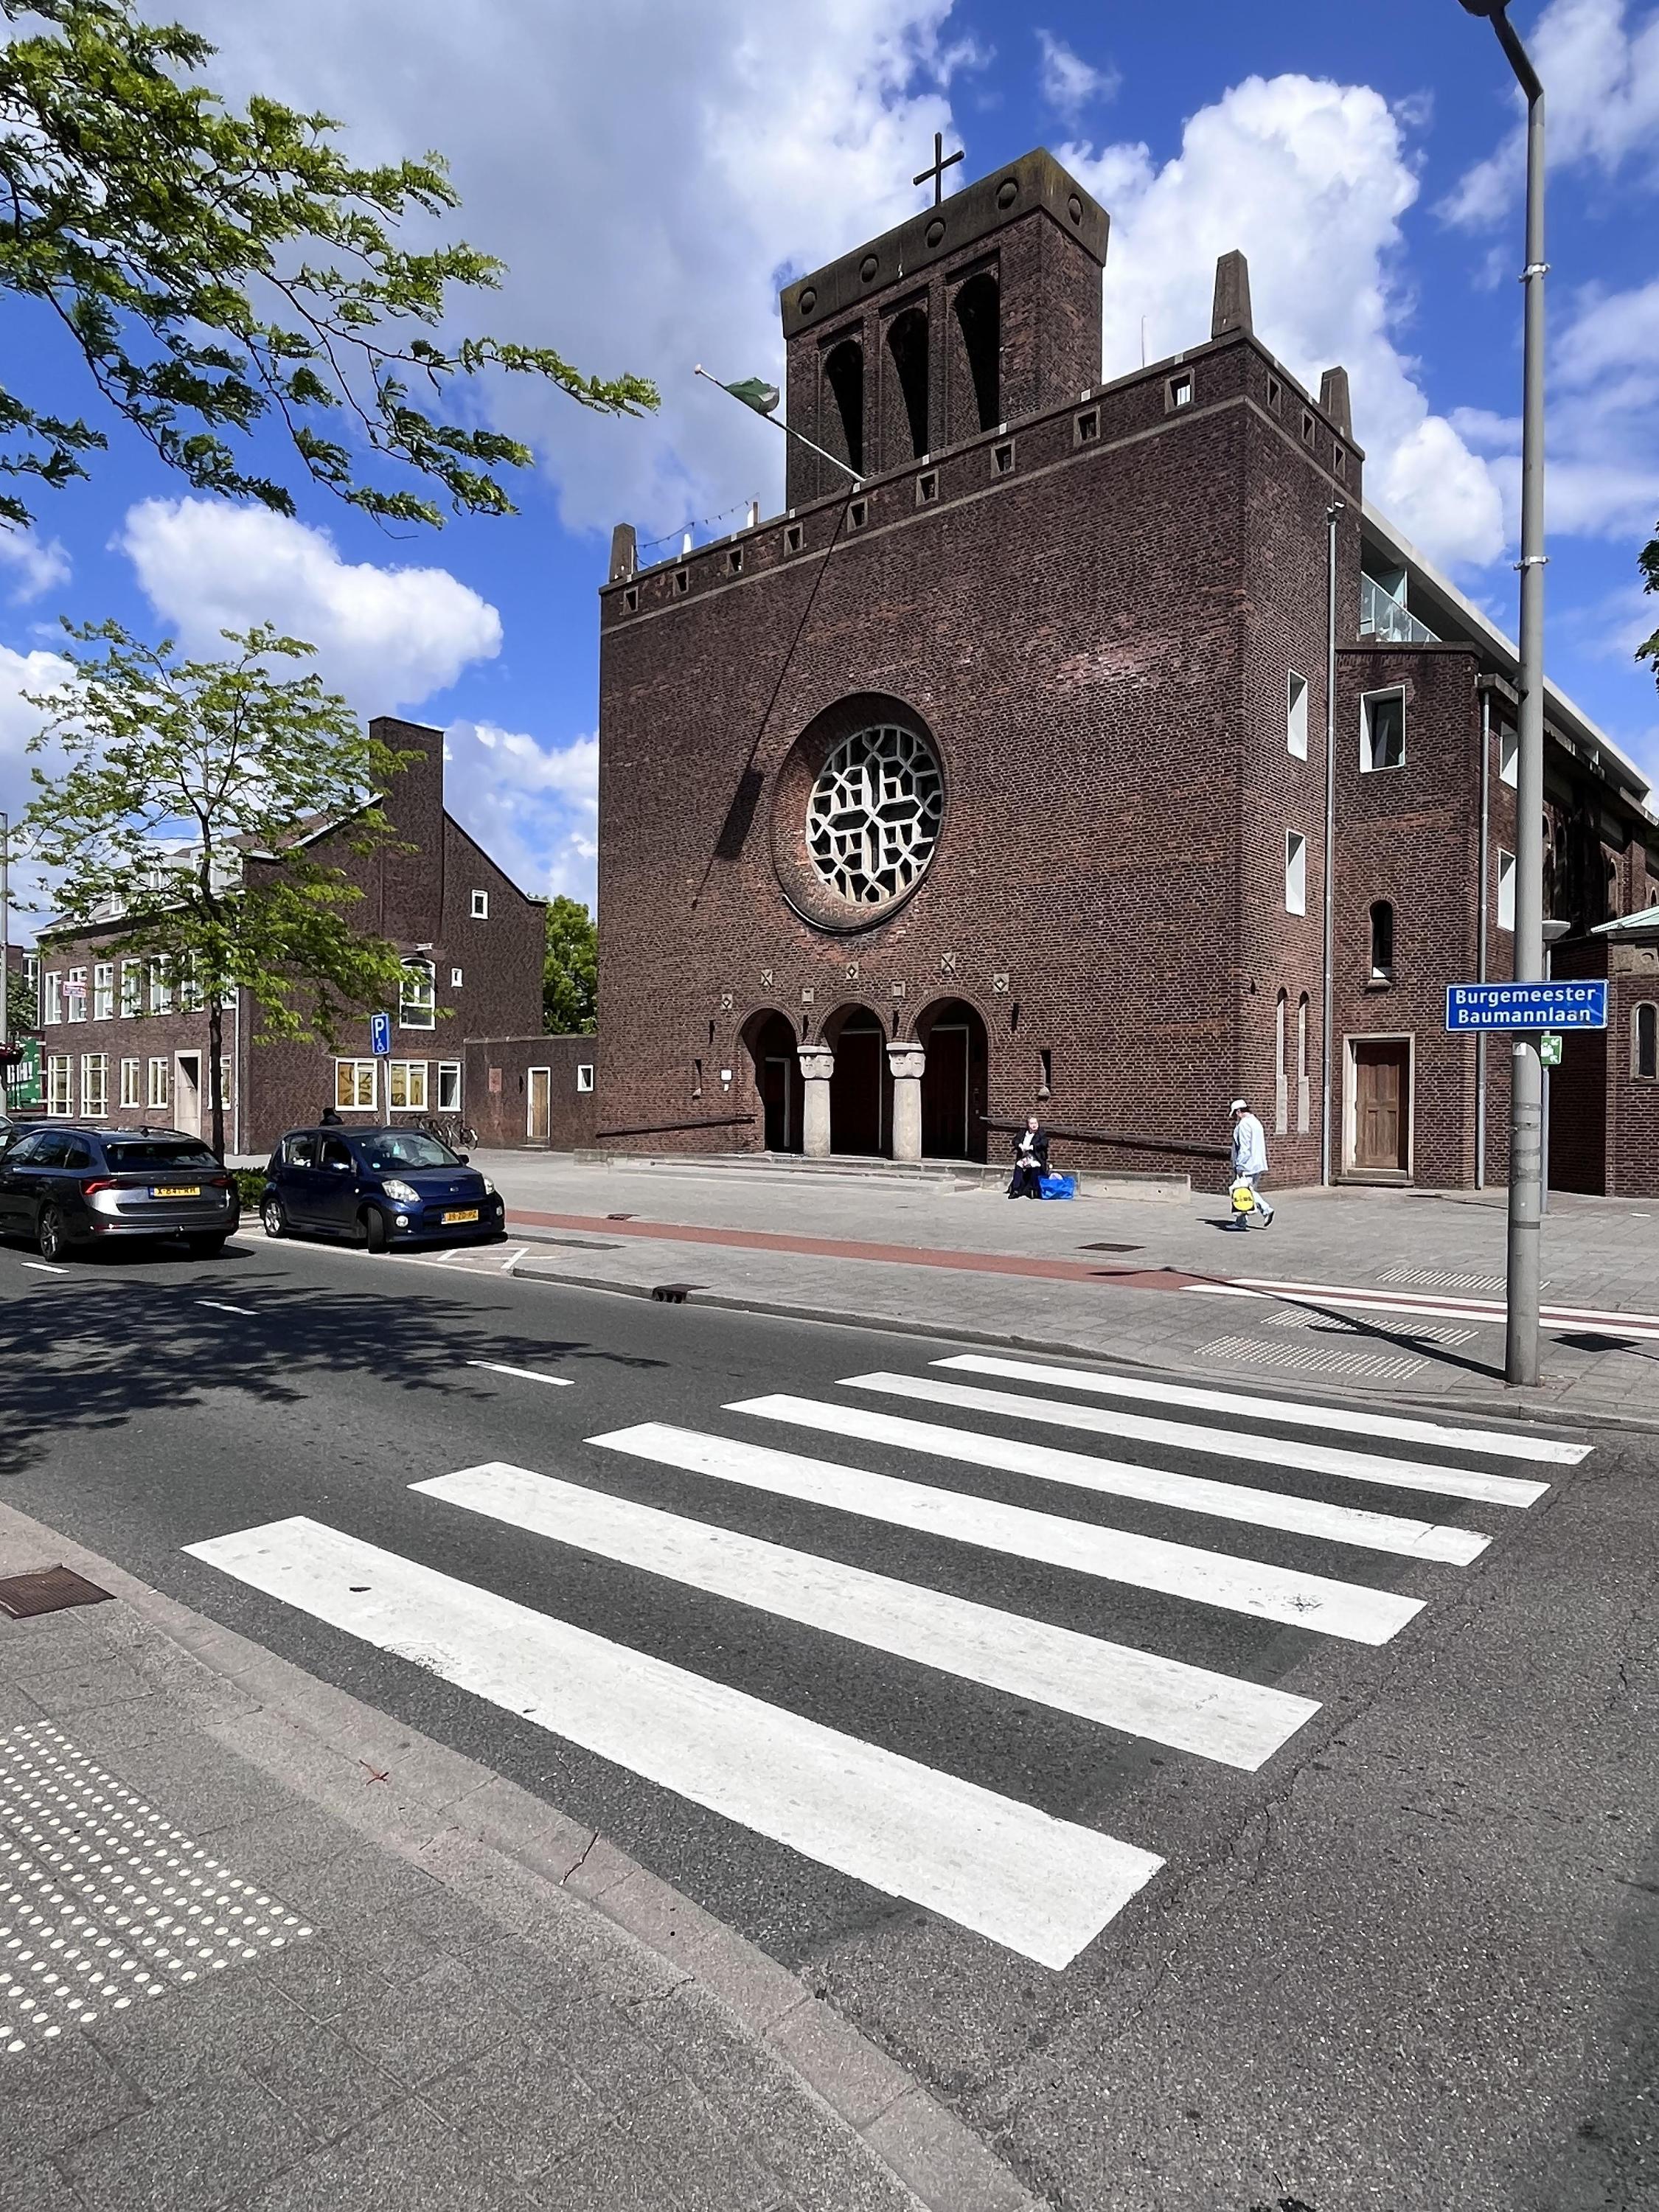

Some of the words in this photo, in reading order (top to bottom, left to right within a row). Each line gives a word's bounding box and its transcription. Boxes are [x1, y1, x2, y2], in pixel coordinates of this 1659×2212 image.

[1455, 987, 1596, 1007] Burgemeester
[1458, 1006, 1590, 1024] Baumannlaan
[375, 1018, 385, 1039] P
